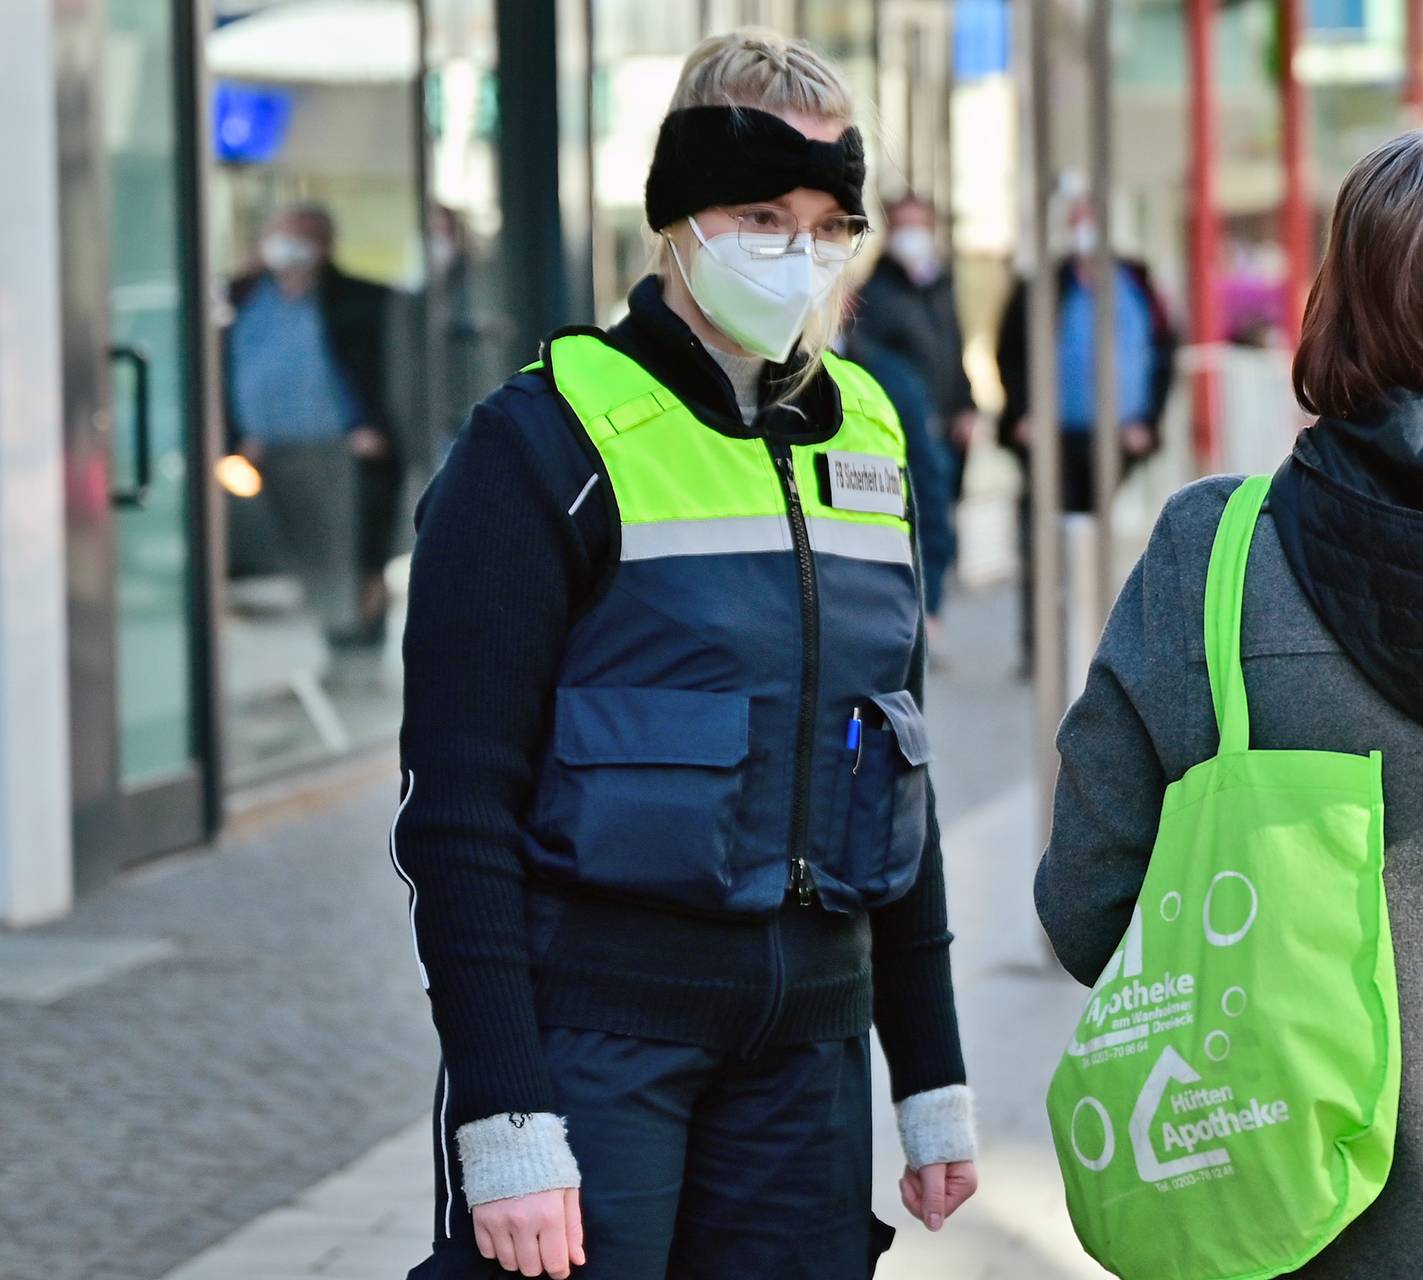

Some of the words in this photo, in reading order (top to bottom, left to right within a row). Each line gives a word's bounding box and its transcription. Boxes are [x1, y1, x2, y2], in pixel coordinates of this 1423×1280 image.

[835, 460, 844, 488] FB
[1085, 971, 1195, 1028] Apotheke
[1111, 1017, 1131, 1030] am
[1152, 1013, 1194, 1034] Dreieck
[1170, 1085, 1234, 1115] Hütten
[1162, 1097, 1290, 1153] Apotheke
